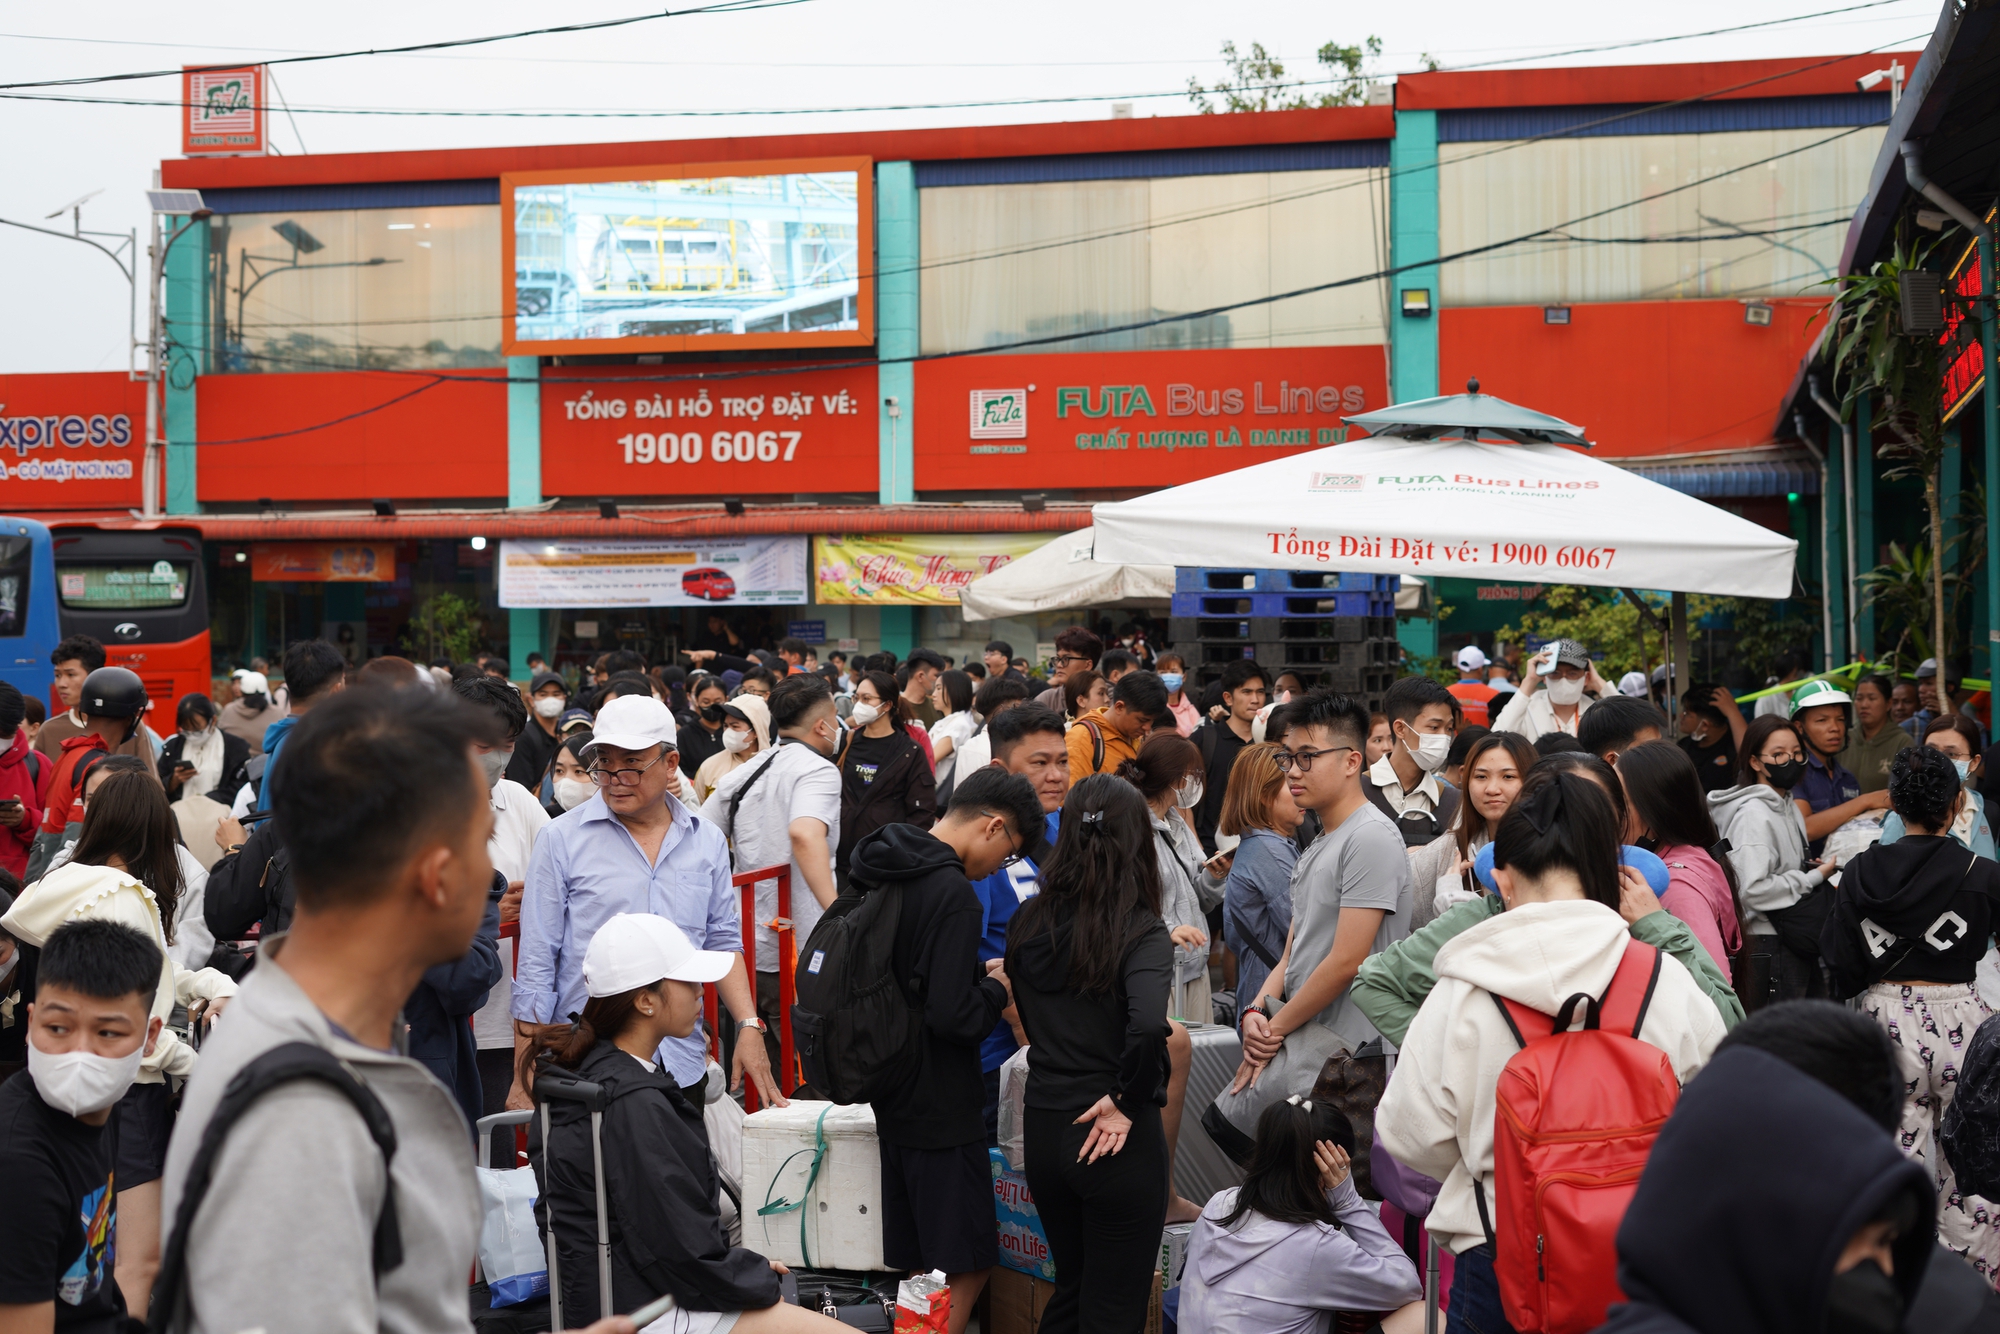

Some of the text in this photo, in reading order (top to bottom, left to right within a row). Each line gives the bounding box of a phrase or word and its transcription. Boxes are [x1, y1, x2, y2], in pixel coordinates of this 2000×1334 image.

[564, 389, 858, 421] TỔNG ĐÀI HỖ TRỢ ĐẶT VÉ:
[982, 395, 1022, 427] FuTa
[1056, 380, 1366, 418] FUTA Bus Lines
[0, 405, 131, 457] xpress
[1076, 426, 1130, 450] CHẤT
[1138, 430, 1208, 452] LƯỢNG
[1215, 426, 1242, 447] LÀ
[1250, 428, 1310, 447] DANH
[617, 431, 802, 464] 1900 6067
[17, 458, 41, 480] CÓ
[75, 459, 102, 479] NƠI
[104, 458, 133, 479] NƠI
[1377, 474, 1600, 489] FUTA Bus Lines
[1267, 527, 1616, 570] Tổng Đài Đặt vé: 1900 6067
[856, 554, 914, 591] Chúc
[906, 555, 975, 595] Mừng
[1477, 583, 1519, 600] PHÒNG
[995, 1178, 1018, 1206] Life
[1022, 1233, 1049, 1260] Life
[1162, 1244, 1170, 1293] eken
